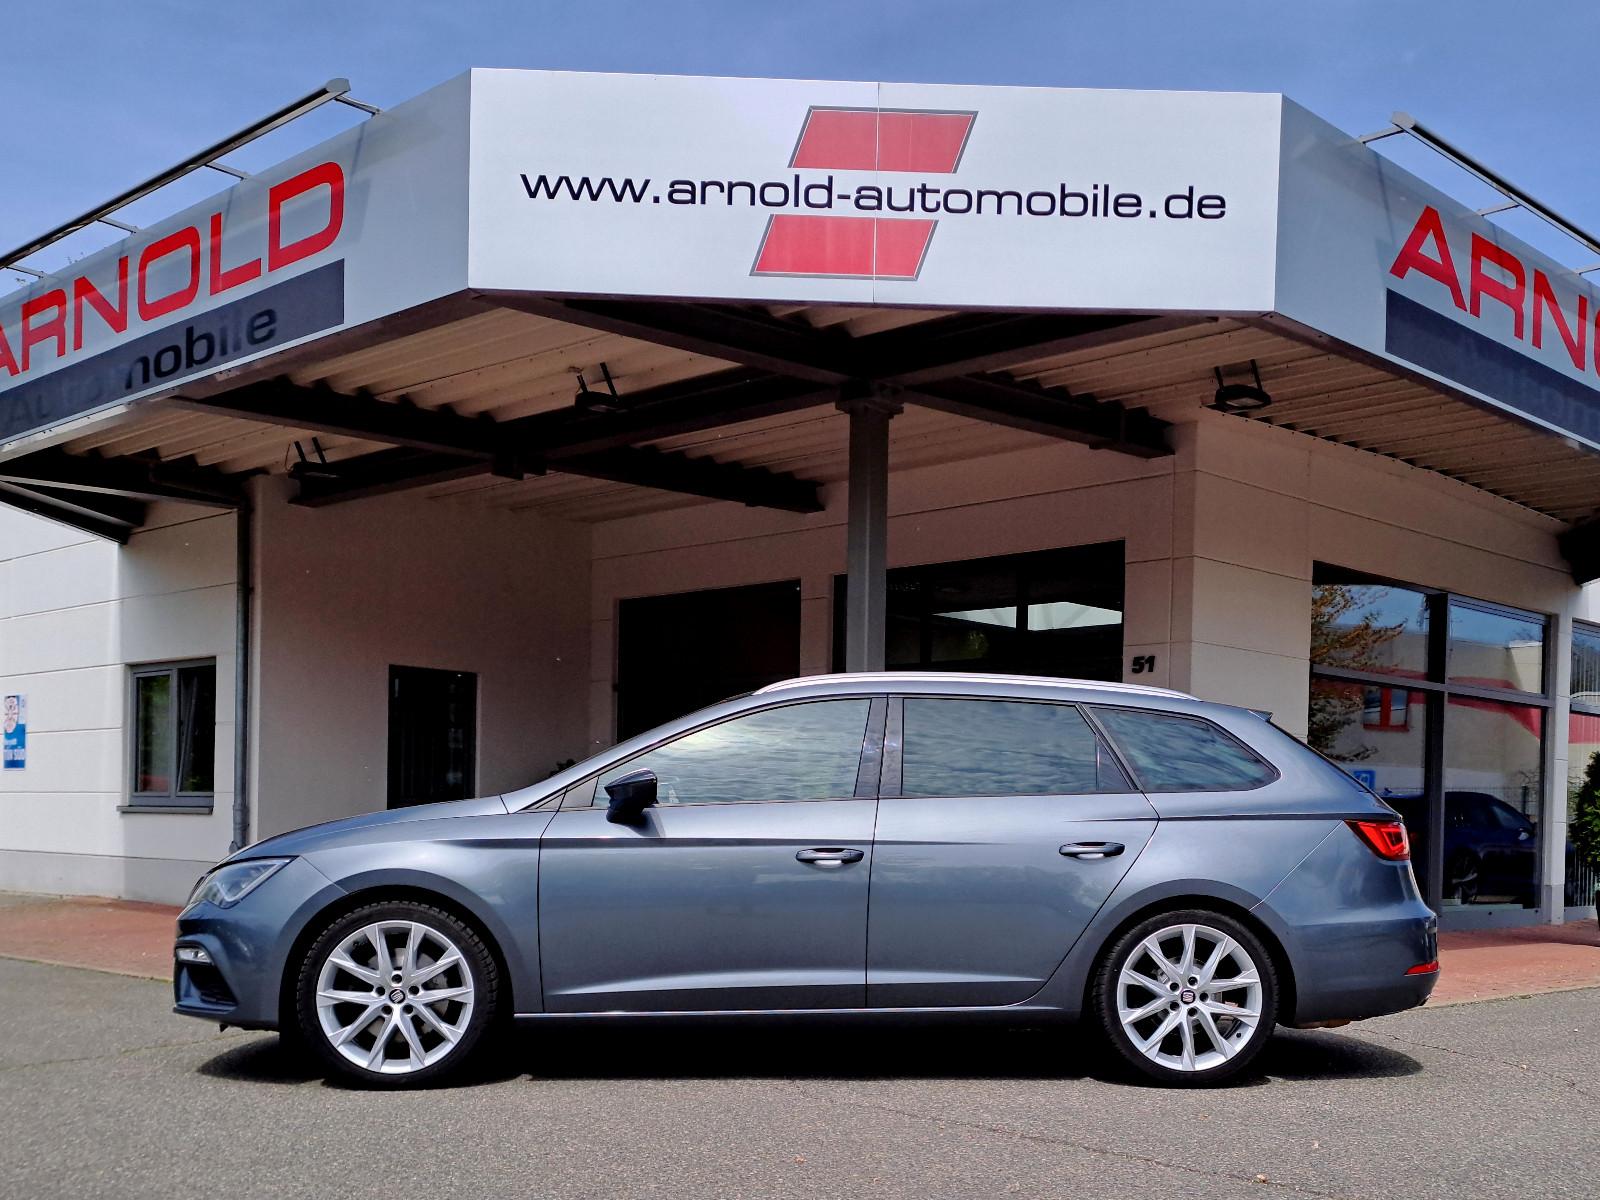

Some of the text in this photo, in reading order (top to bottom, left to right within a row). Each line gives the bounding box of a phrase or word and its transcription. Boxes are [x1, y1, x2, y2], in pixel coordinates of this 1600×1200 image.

[519, 173, 1227, 220] www.arnold-automobile.de
[1389, 205, 1600, 378] ARN
[1131, 655, 1156, 674] 51
